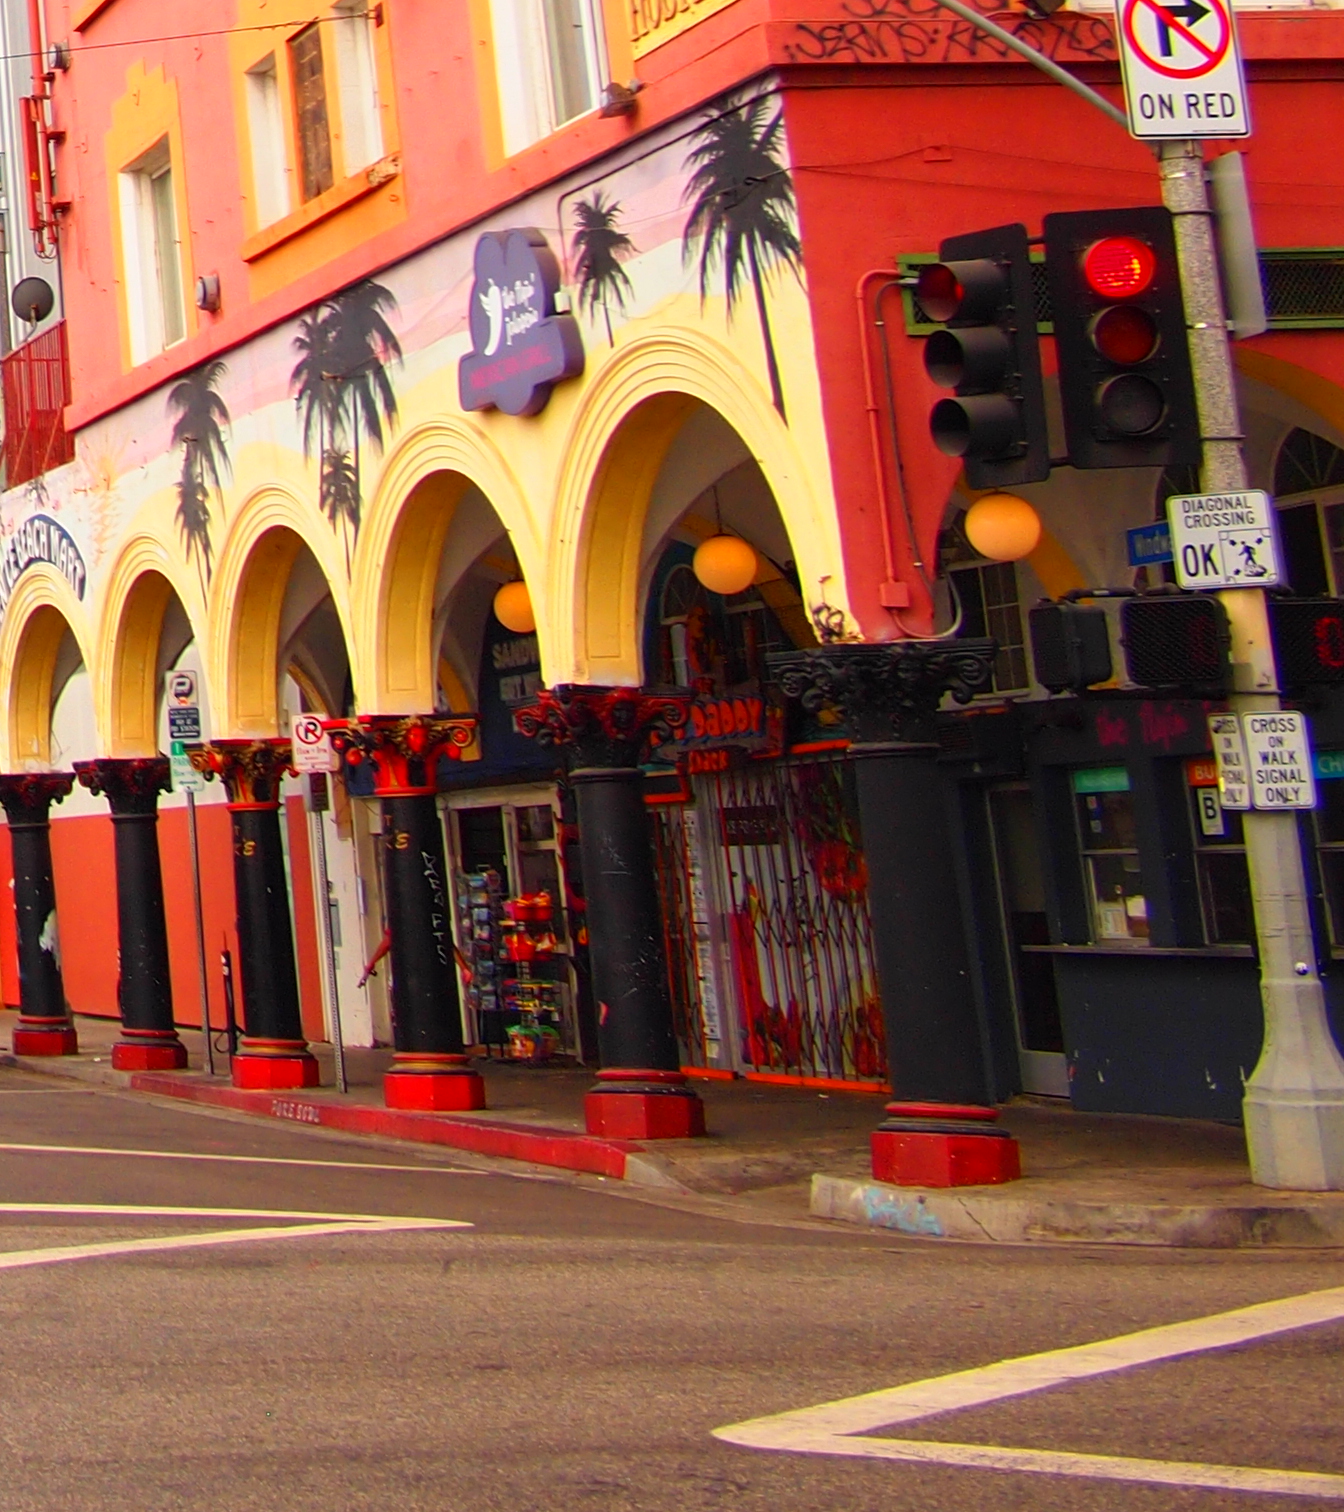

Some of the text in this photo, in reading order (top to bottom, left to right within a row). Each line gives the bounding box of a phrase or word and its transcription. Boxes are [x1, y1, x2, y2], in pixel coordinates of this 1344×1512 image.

[1139, 92, 1235, 119] ON RED
[1182, 495, 1253, 514] DIAGONAL
[1184, 511, 1256, 530] CROSSING
[50, 525, 87, 602] MART
[1182, 543, 1220, 578] OK
[1251, 717, 1296, 733] CROSS
[1268, 736, 1284, 748] ON
[1259, 751, 1297, 765] WALK
[1256, 769, 1307, 784] SIGNAL
[1266, 787, 1300, 803] ONLY
[1202, 795, 1217, 820] B
